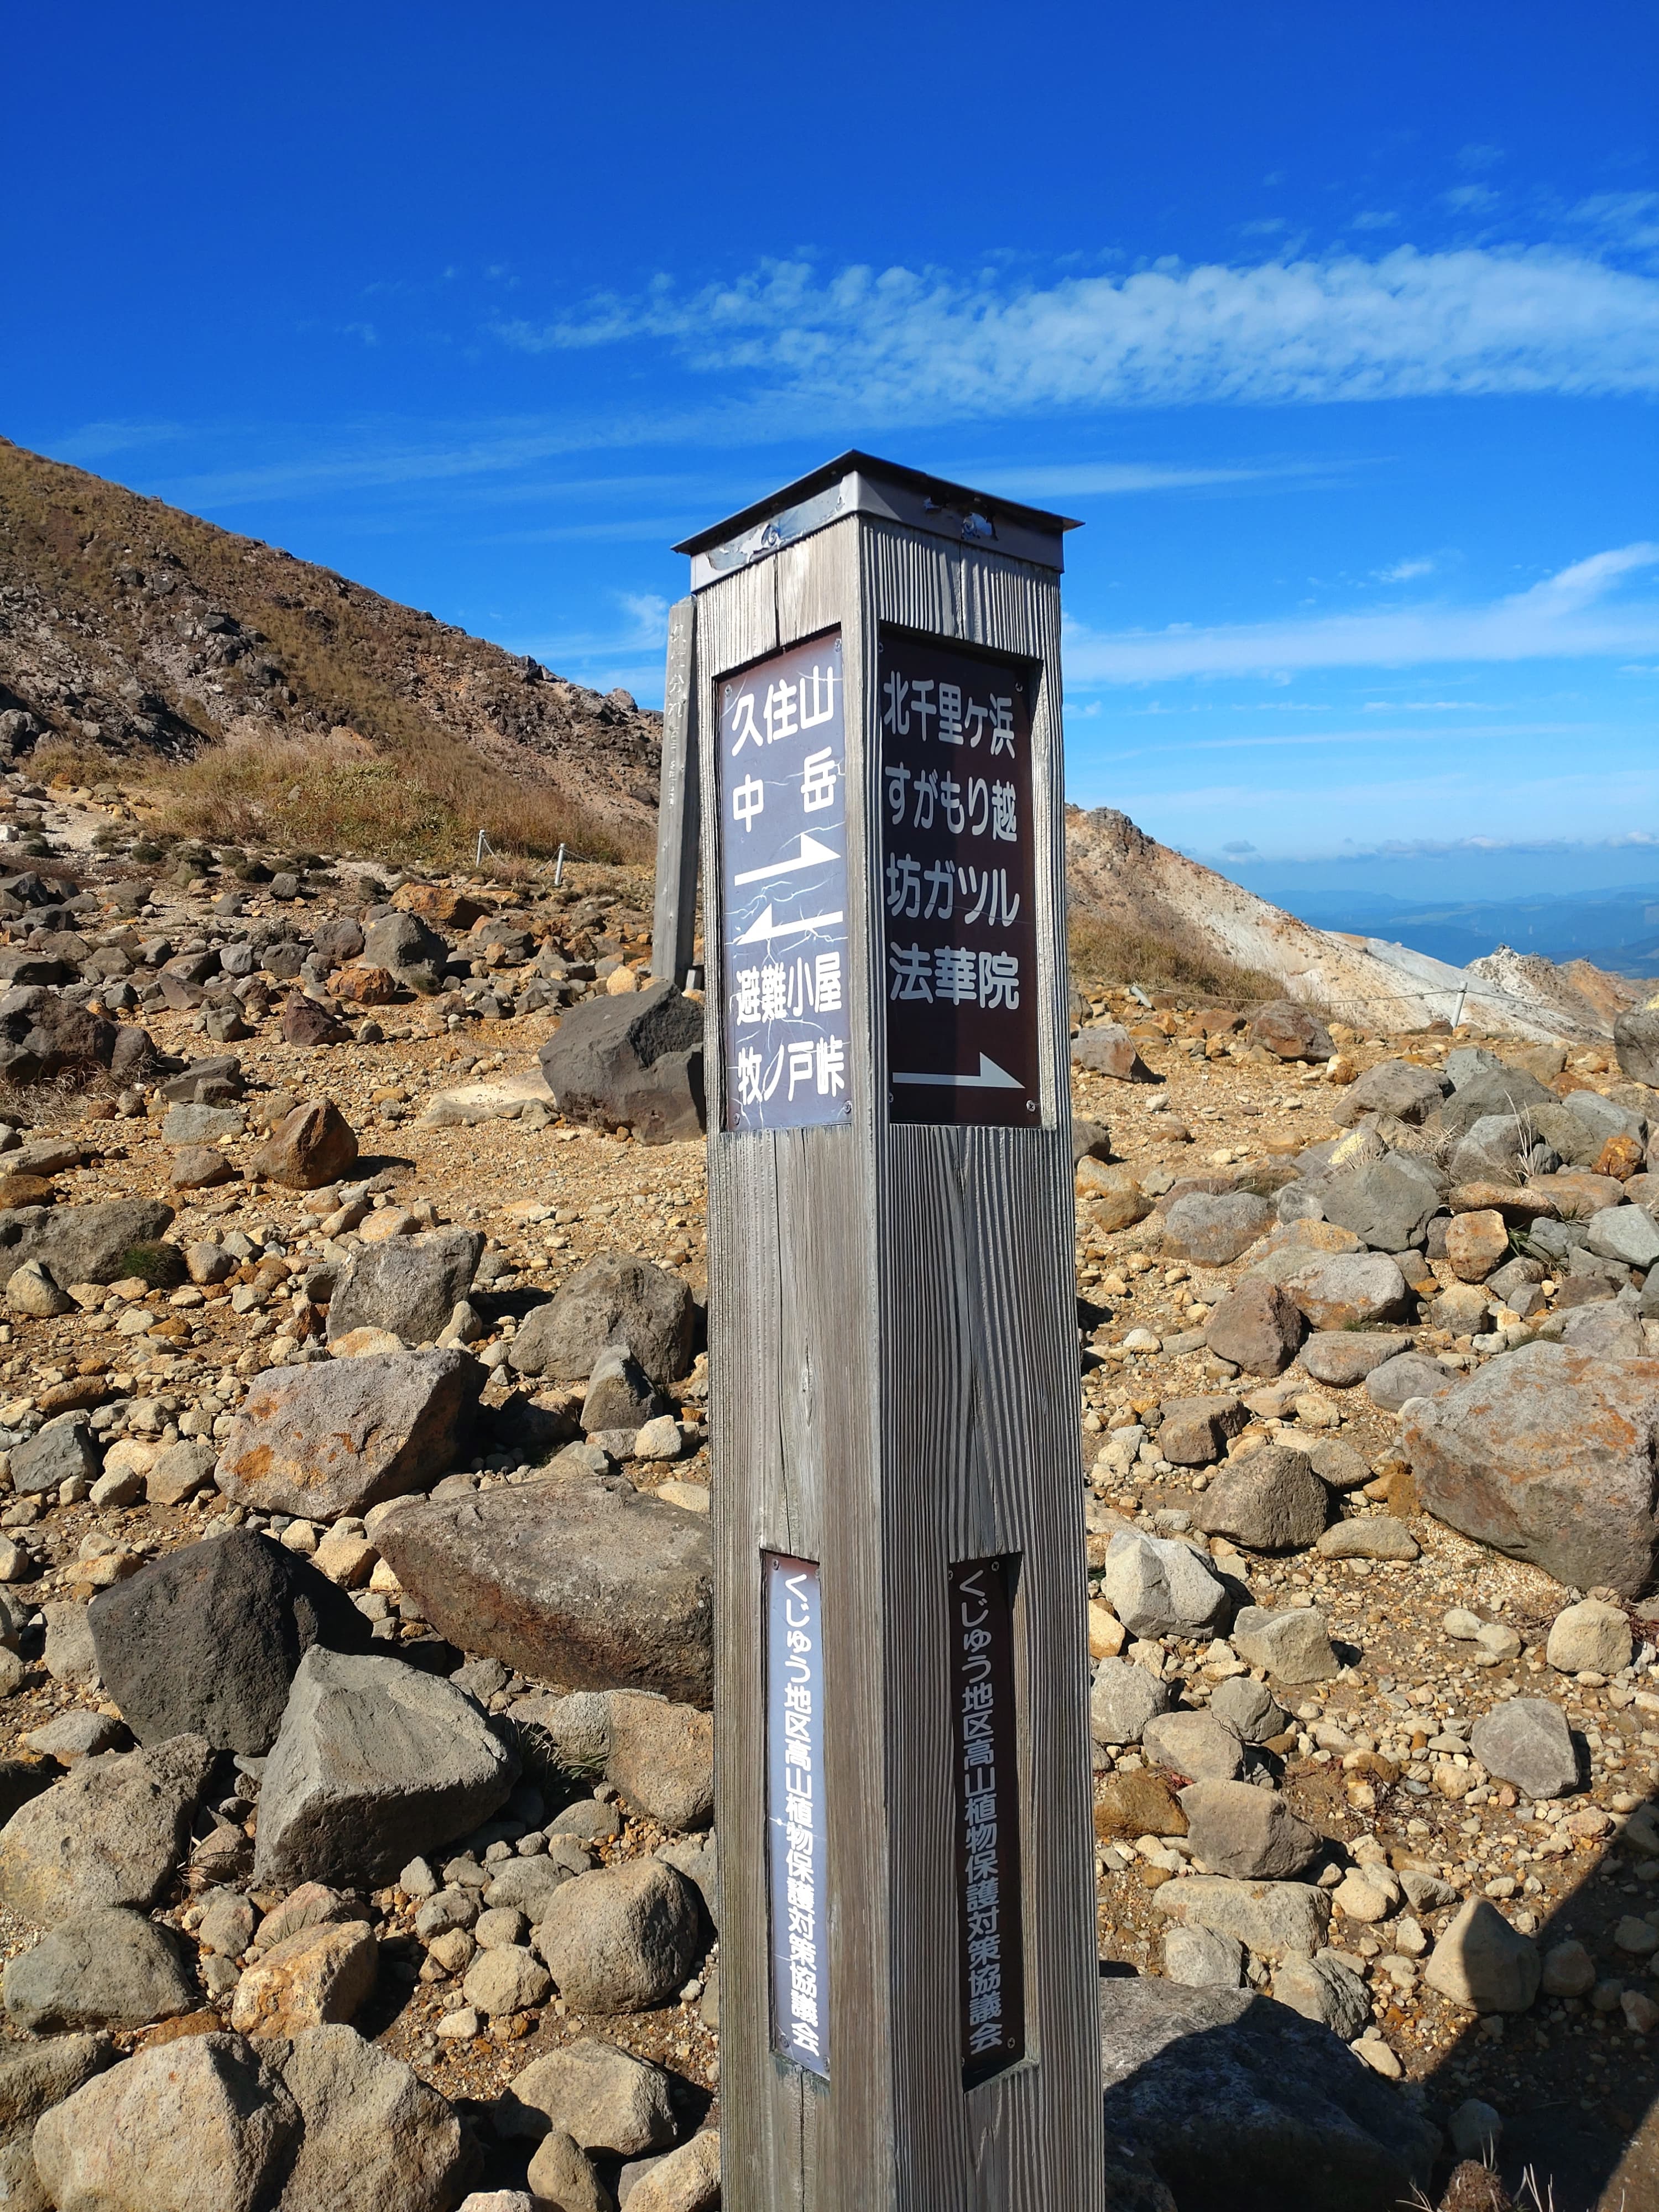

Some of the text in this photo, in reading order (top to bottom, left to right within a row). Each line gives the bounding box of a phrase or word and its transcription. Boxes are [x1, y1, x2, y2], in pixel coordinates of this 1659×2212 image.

[732, 665, 834, 757] 久住山
[885, 761, 1018, 843] すがもり越
[886, 852, 1019, 927] 坊ガツル
[736, 951, 843, 1026] 避難小屋
[889, 942, 1020, 1011] 法華院
[737, 1035, 846, 1105] 牧ノ戸峠
[784, 1573, 820, 2057] くじゅう地区高山植物保護対策協議会
[958, 1569, 1003, 2054] くじゅう地区高山植物保護対策協議会
